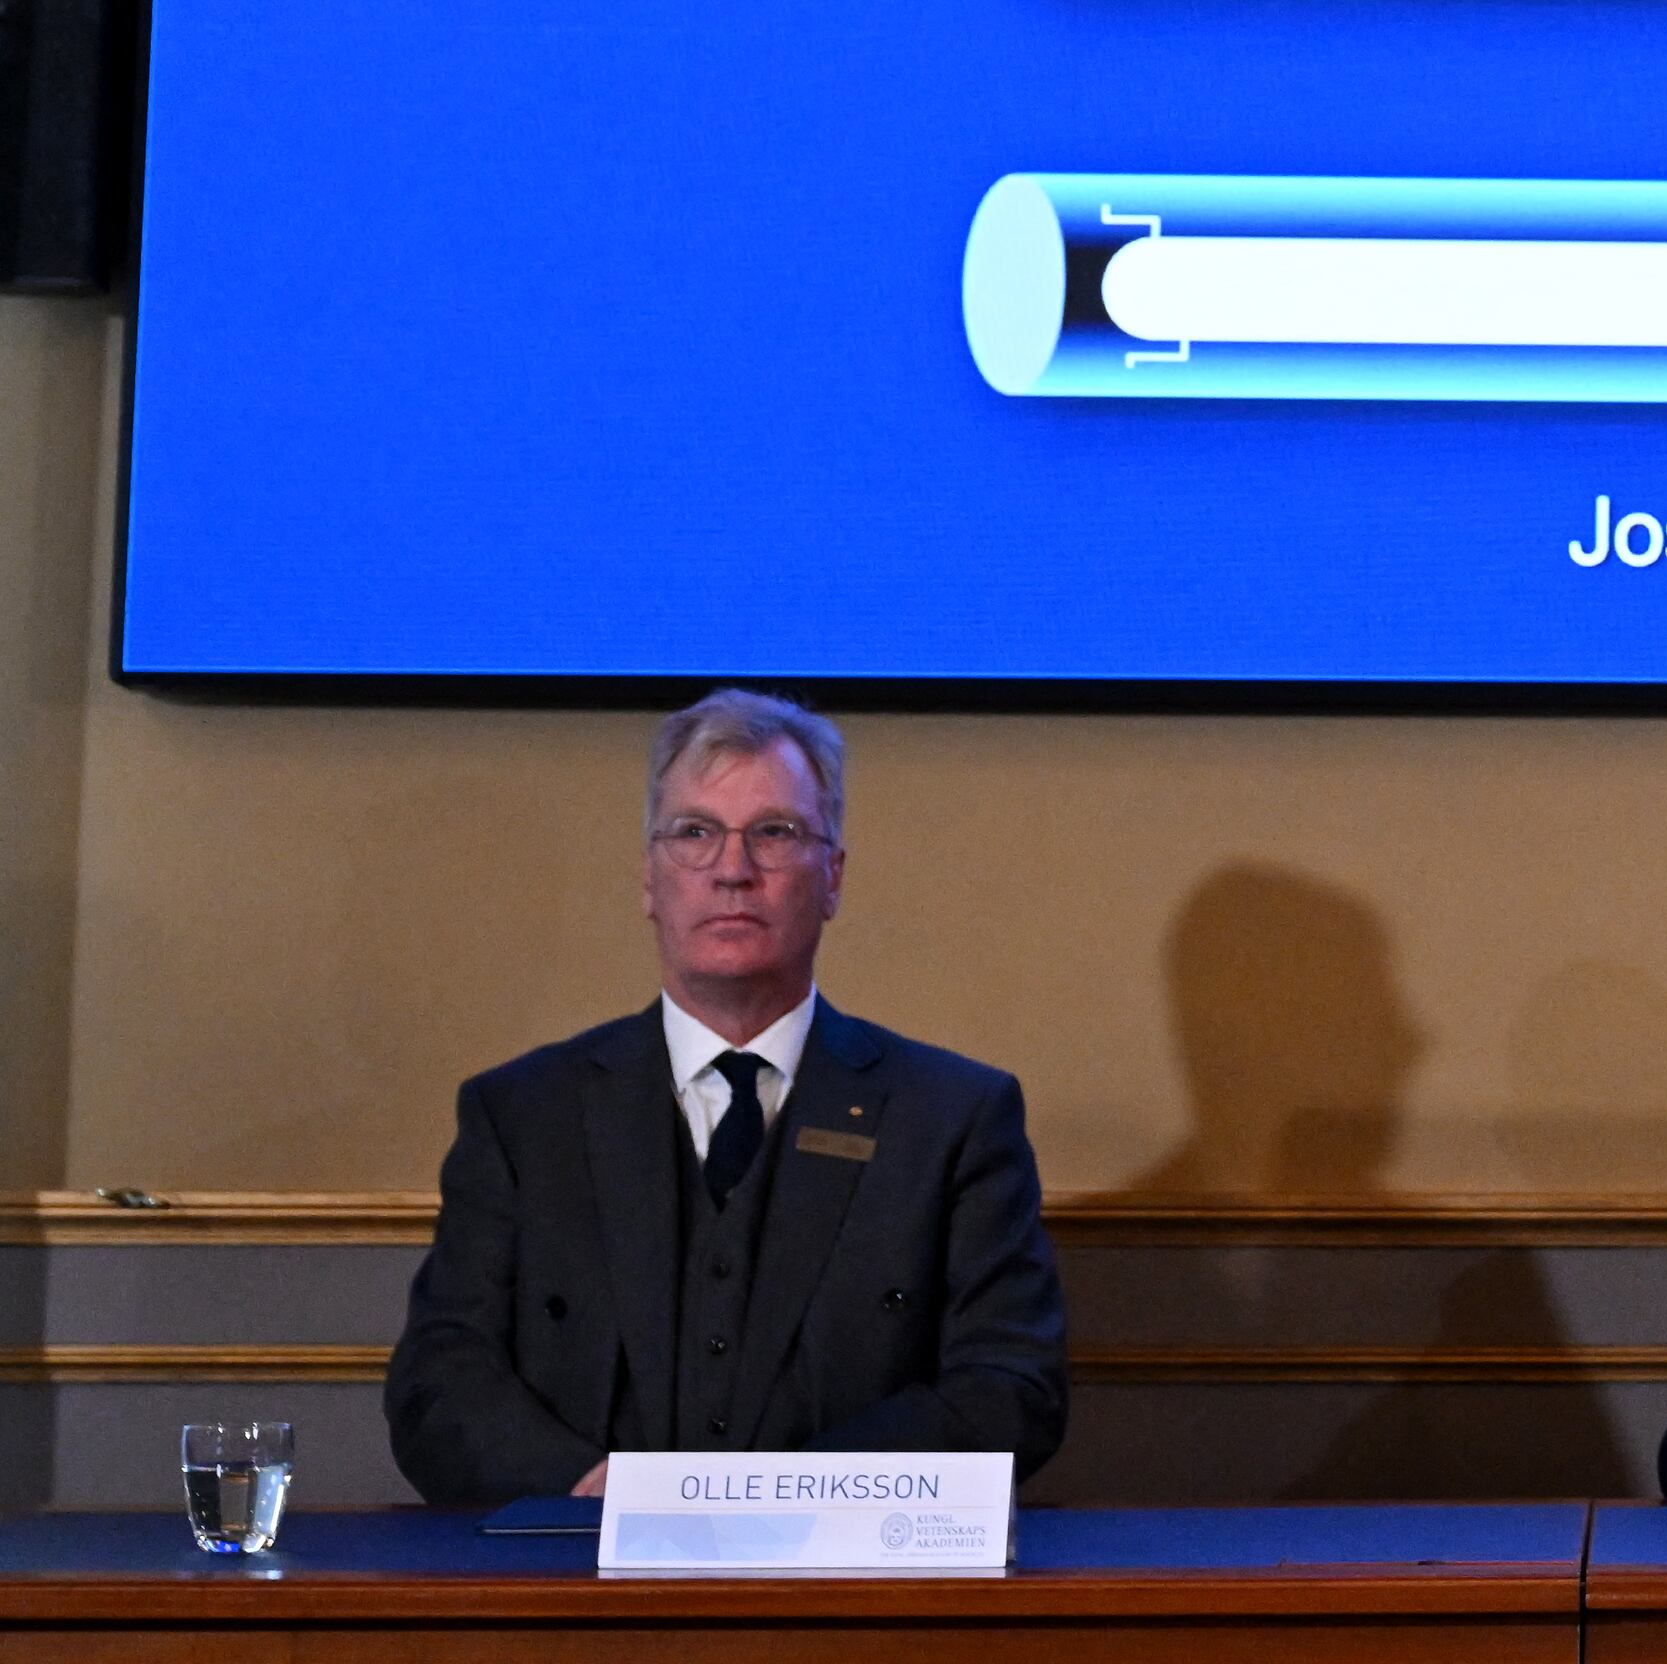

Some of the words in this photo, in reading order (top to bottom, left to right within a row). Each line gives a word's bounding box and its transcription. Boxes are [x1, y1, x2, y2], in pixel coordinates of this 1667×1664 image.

[680, 1474, 764, 1501] OLLE
[775, 1474, 939, 1500] ERIKSSON
[915, 1537, 986, 1549] AKADEMIEN
